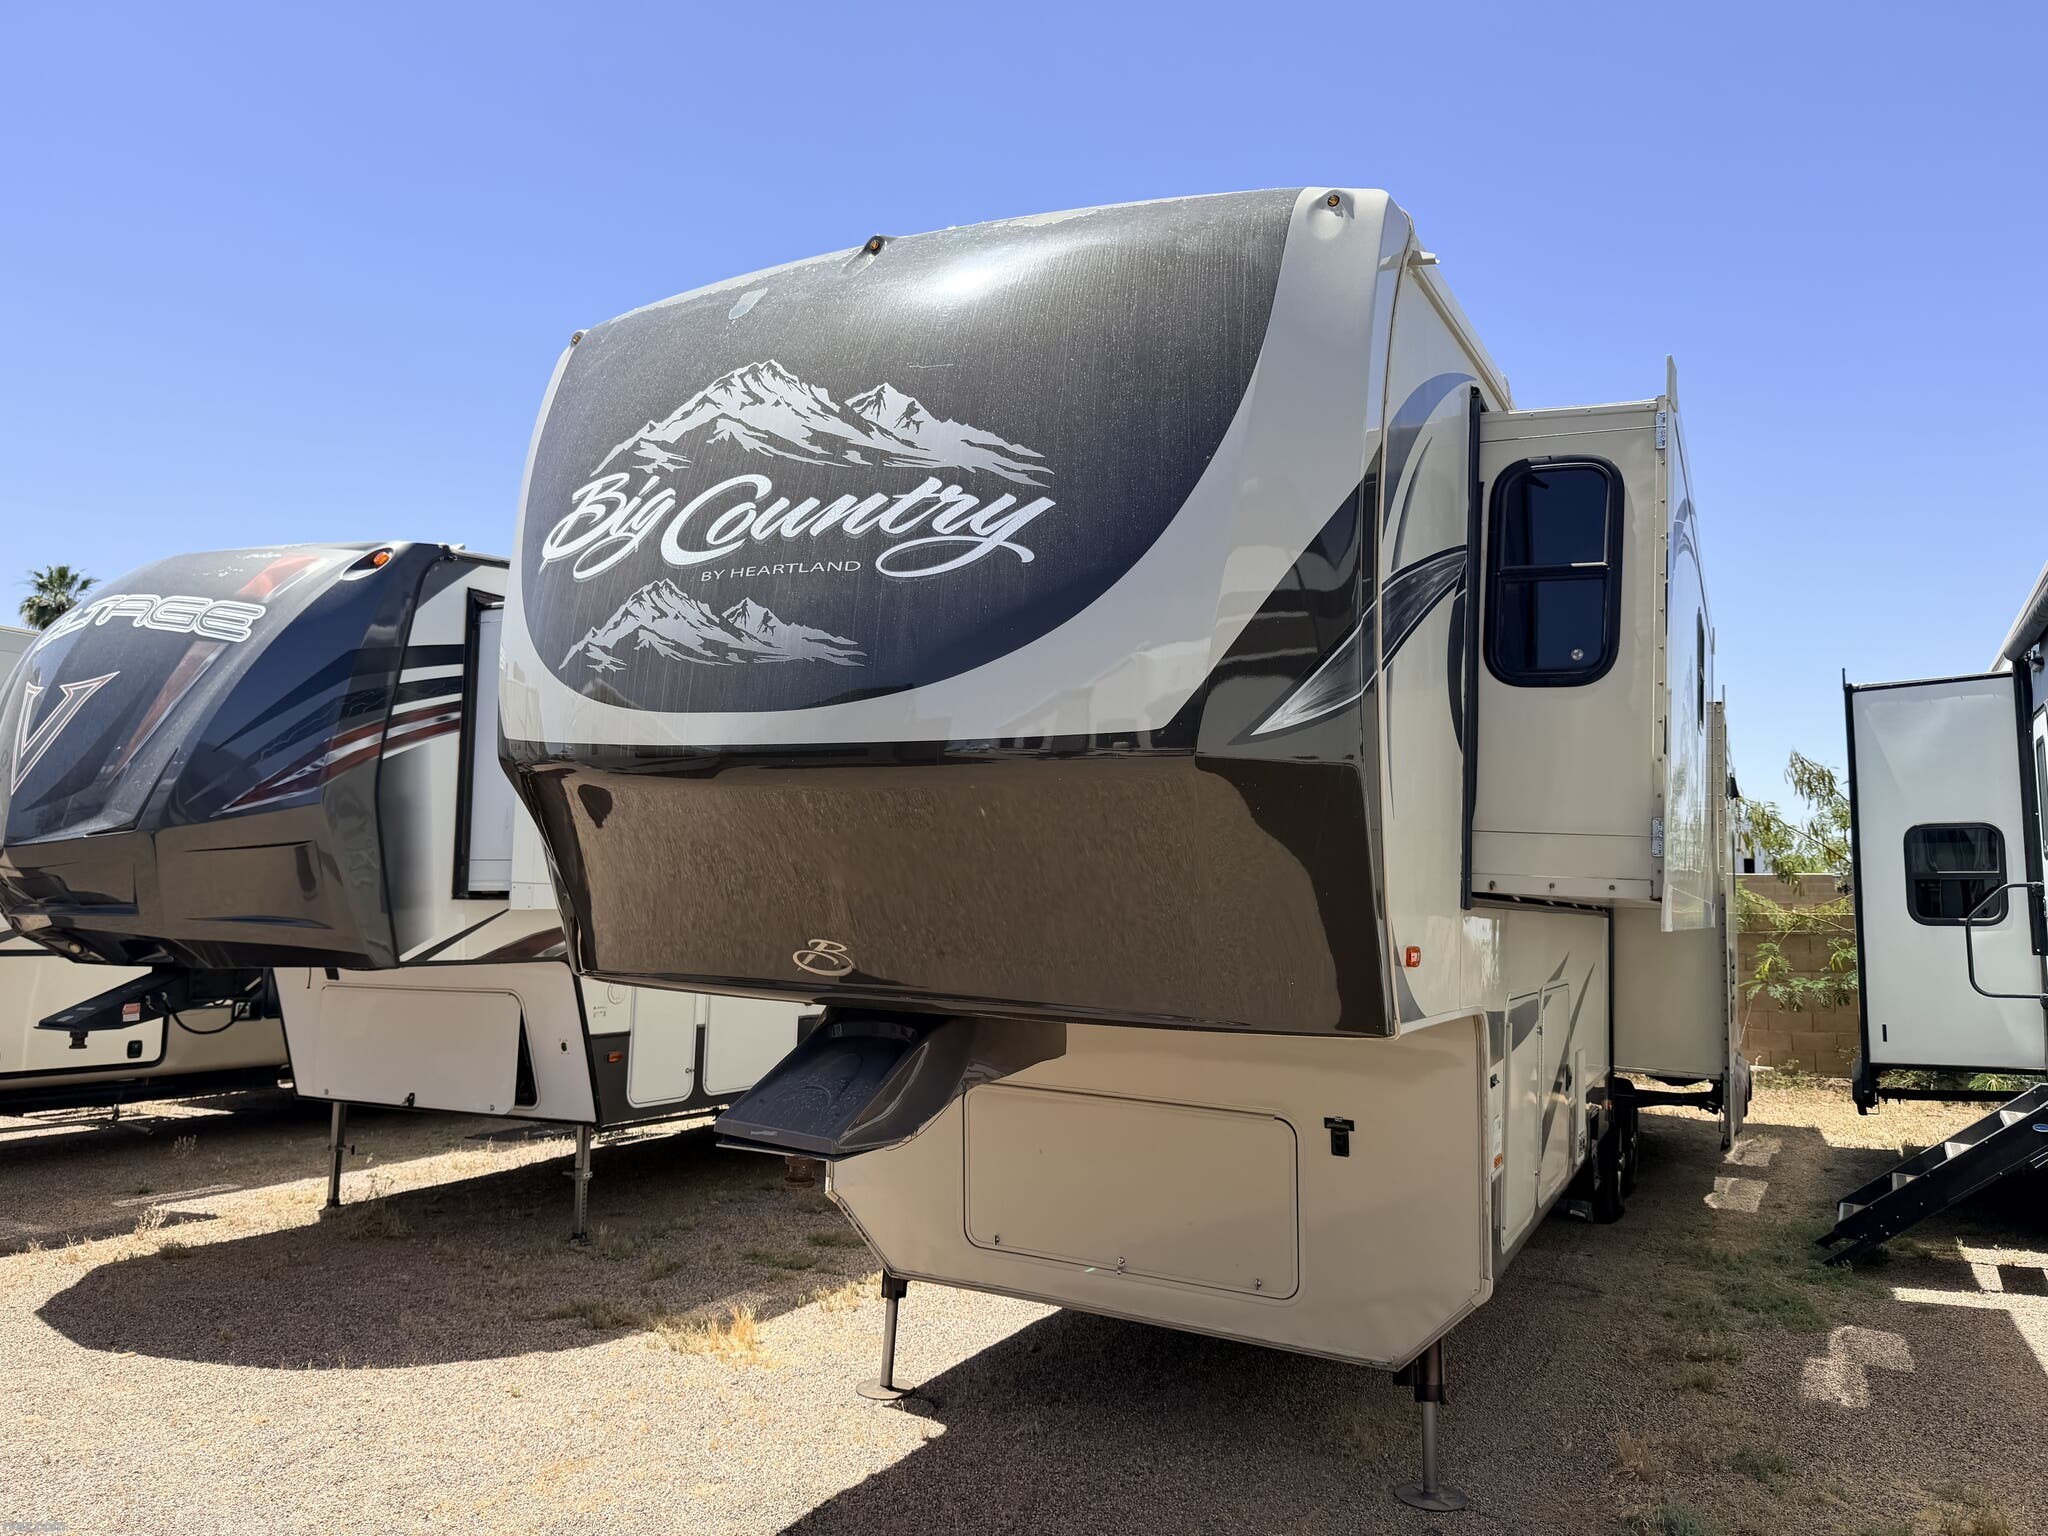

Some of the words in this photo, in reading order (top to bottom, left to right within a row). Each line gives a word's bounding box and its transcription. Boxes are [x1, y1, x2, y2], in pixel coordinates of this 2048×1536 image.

[538, 472, 677, 581] Big
[660, 473, 1057, 580] Country
[700, 569, 726, 582] BY
[730, 560, 862, 578] HEARTLAND
